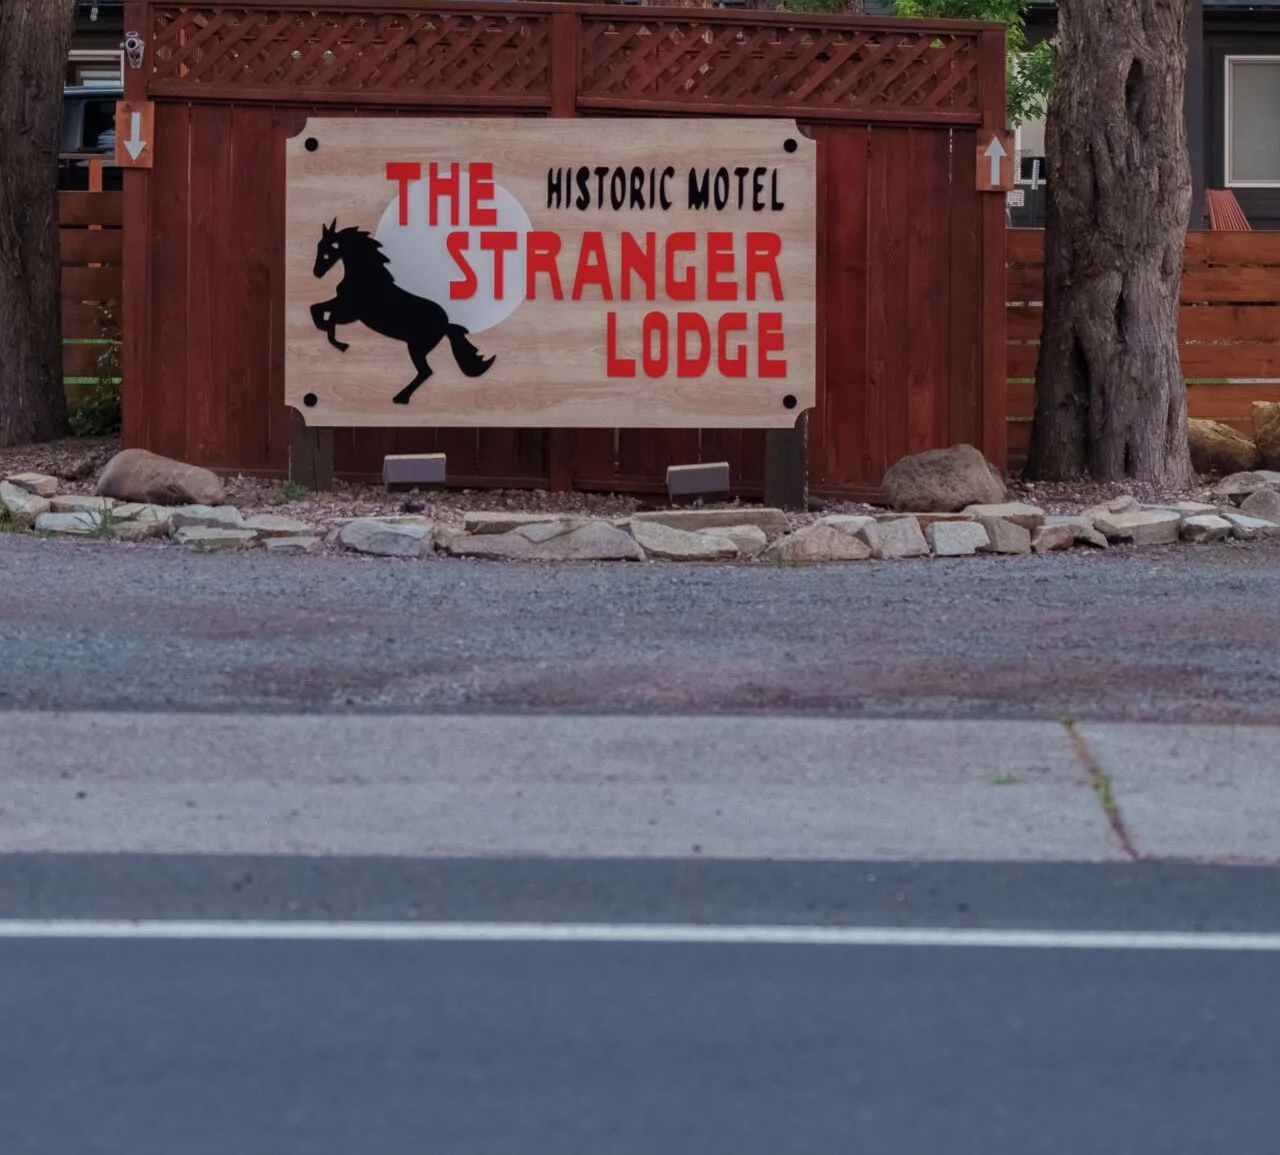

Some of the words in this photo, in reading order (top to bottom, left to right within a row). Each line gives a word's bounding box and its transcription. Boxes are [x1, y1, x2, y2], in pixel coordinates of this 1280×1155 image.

[386, 162, 497, 226] THE
[548, 166, 675, 211] HISTORIC
[688, 166, 785, 212] MOTEL
[447, 231, 784, 301] STRANGER
[607, 311, 788, 379] LODGE
